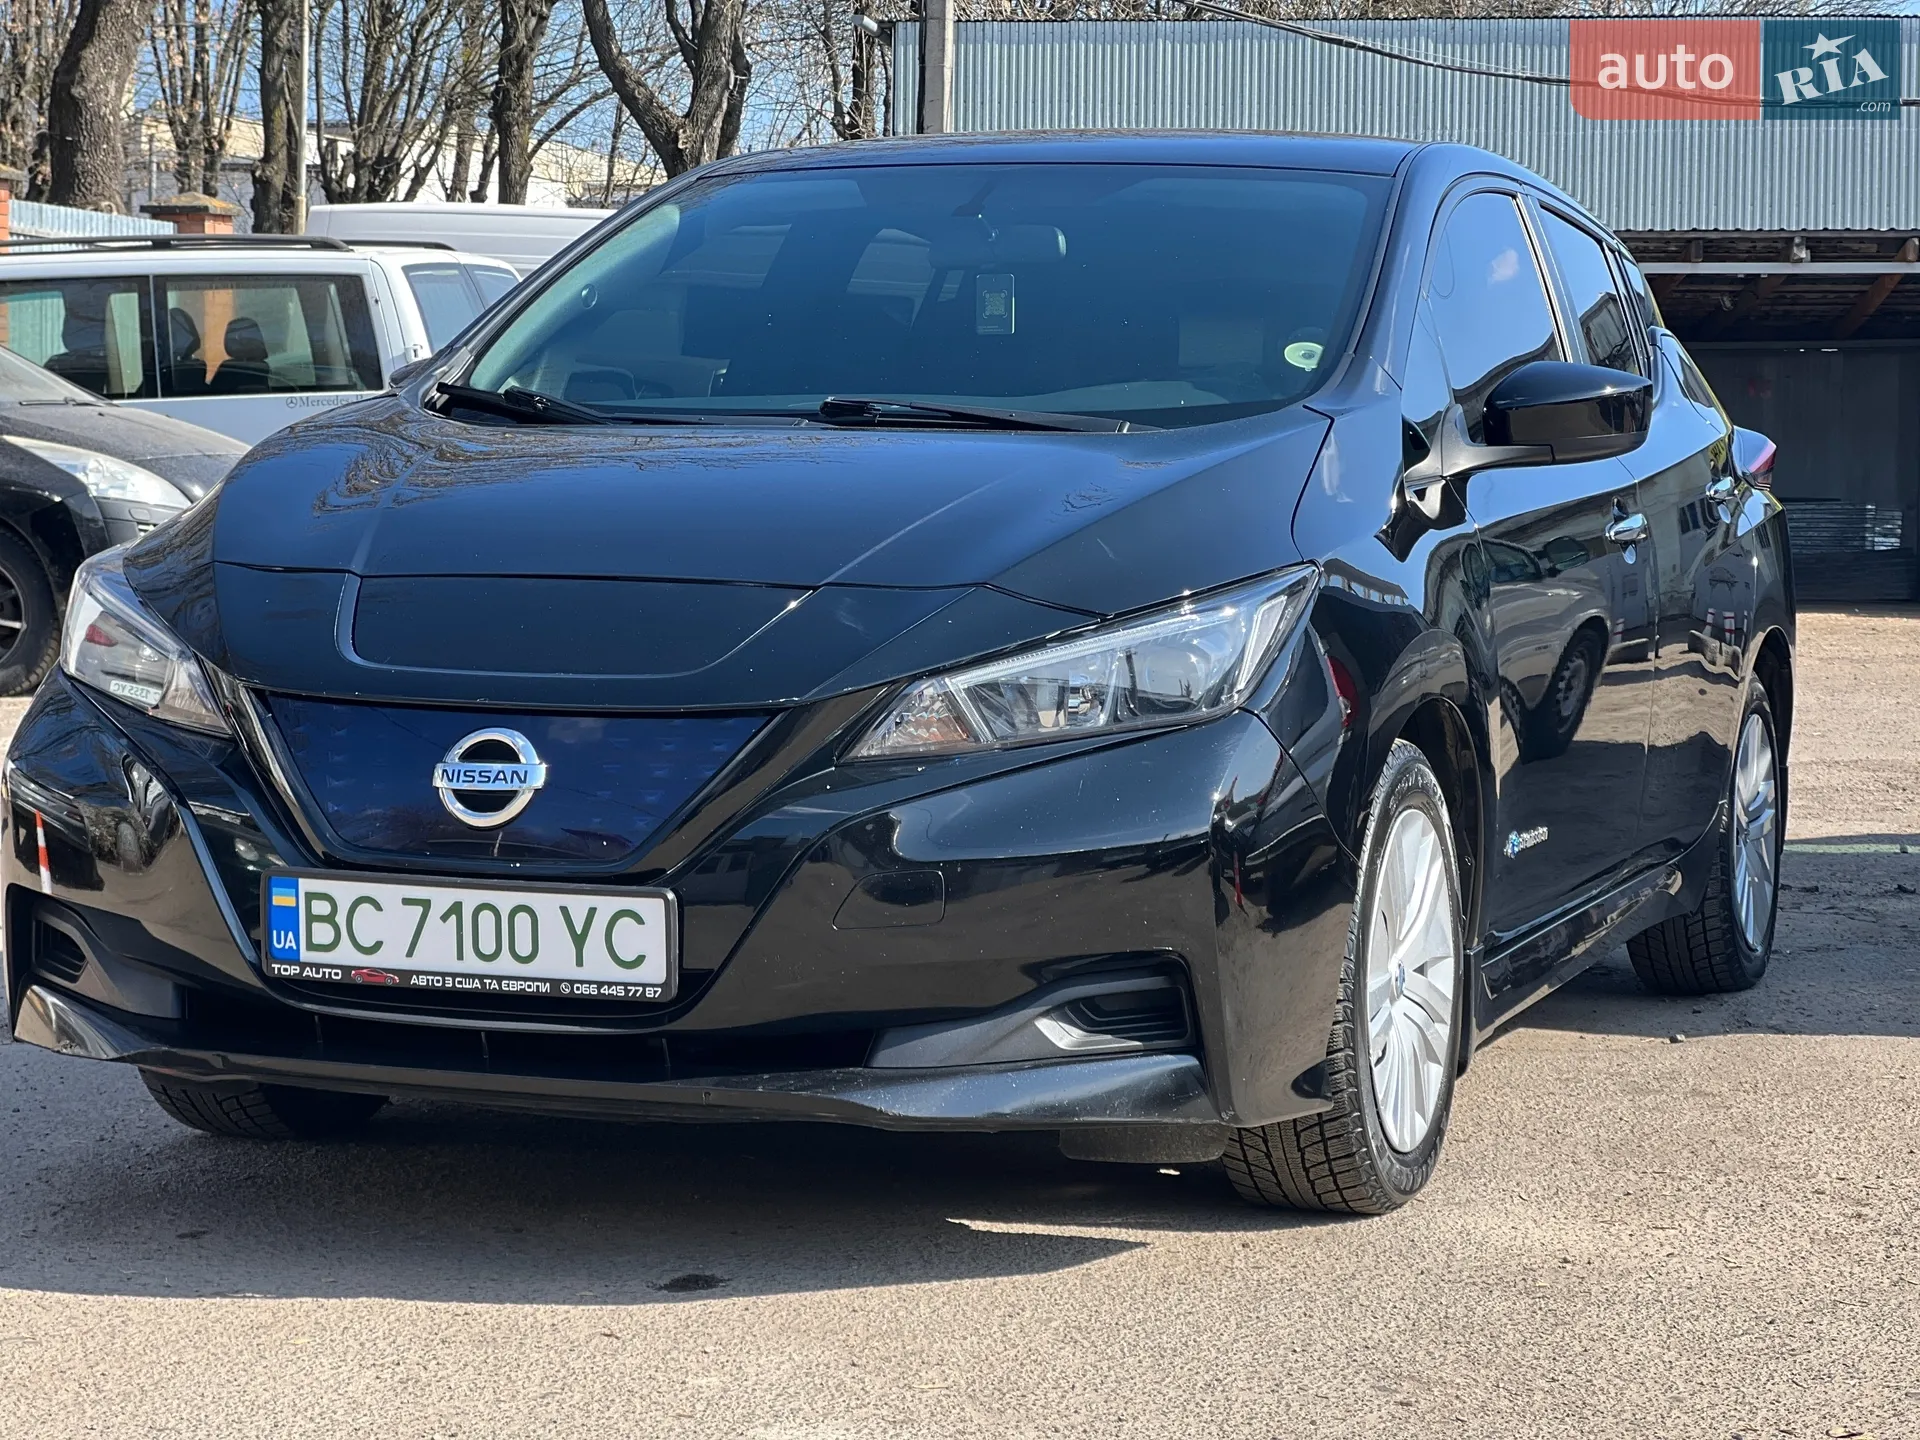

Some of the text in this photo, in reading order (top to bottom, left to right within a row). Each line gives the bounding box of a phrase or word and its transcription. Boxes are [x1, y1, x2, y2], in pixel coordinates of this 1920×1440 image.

[441, 768, 528, 785] NISSAN
[304, 891, 647, 970] BC 7100 YC
[273, 930, 297, 950] UA
[271, 963, 342, 980] TOP AUTO
[410, 975, 443, 988] АВТО
[455, 977, 482, 990] США
[483, 979, 500, 991] ТА
[501, 980, 550, 993] ЄВРОПИ
[573, 984, 662, 998] 066 445 77 87
